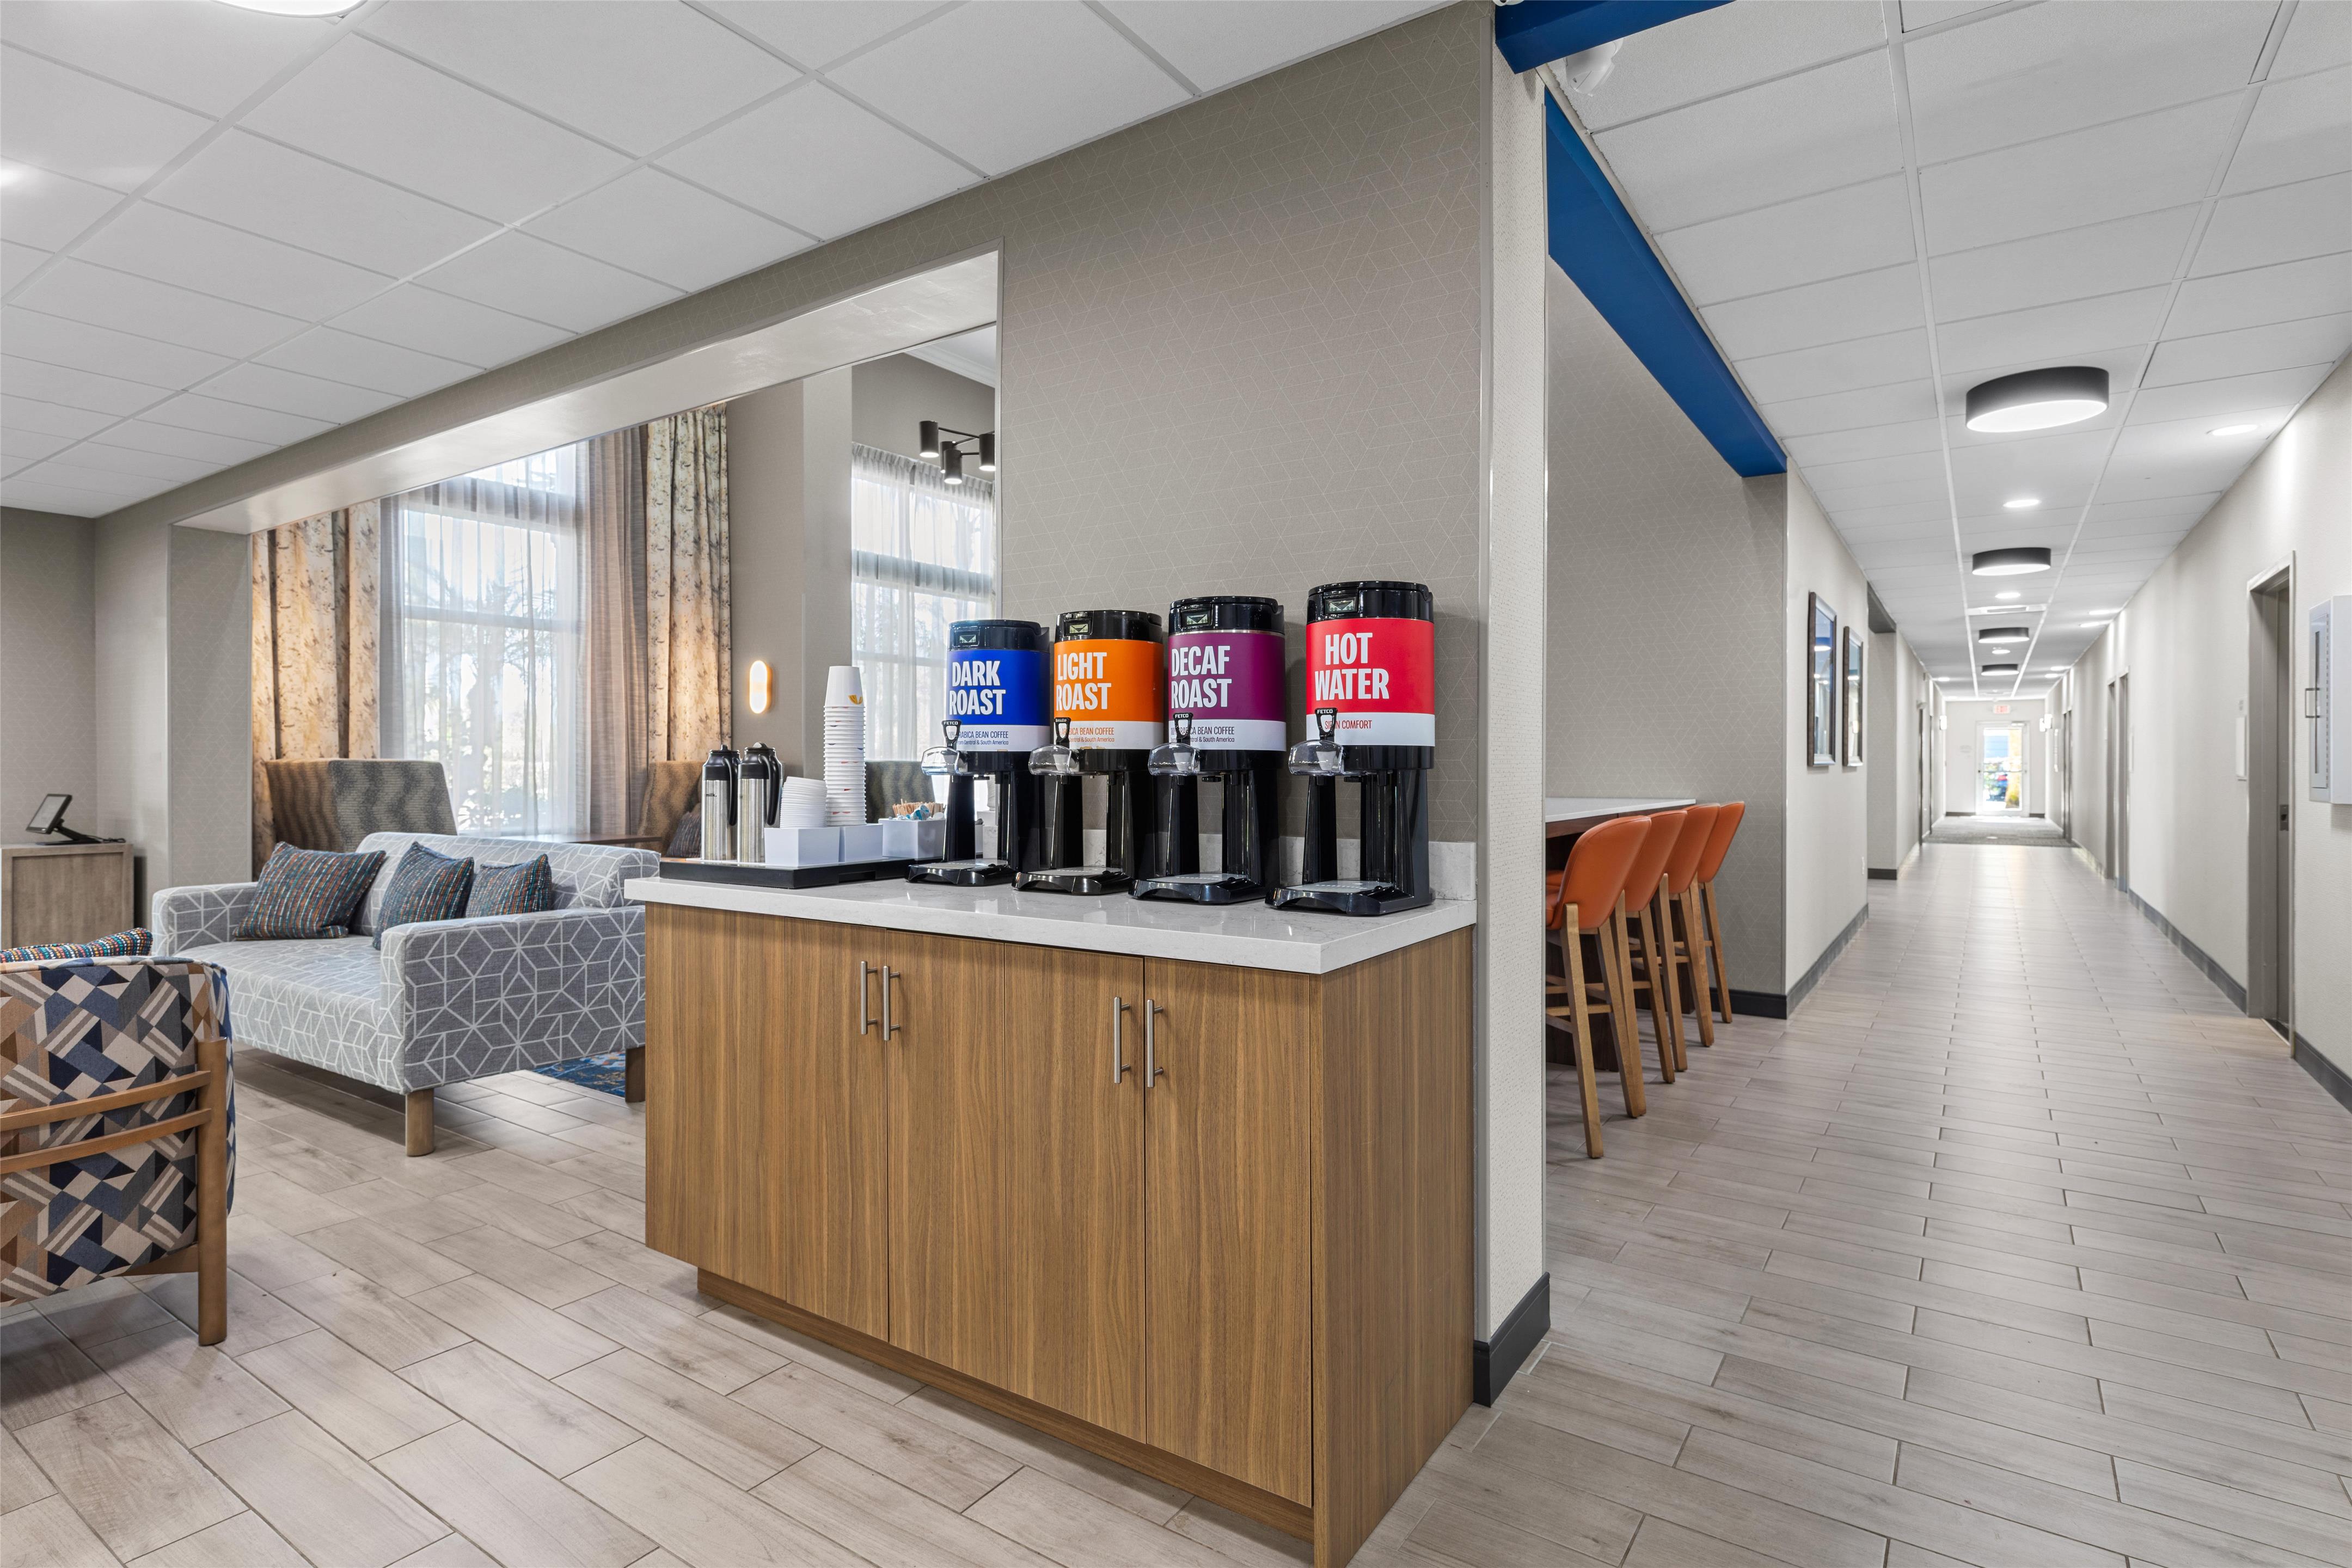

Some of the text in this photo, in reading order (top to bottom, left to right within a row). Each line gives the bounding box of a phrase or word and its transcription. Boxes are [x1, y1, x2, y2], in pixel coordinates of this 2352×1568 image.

[1172, 646, 1230, 677] DECAF
[1325, 633, 1373, 665] HOT
[952, 660, 1001, 687] DARK
[1058, 652, 1107, 681] LIGHT
[1056, 682, 1112, 711] ROAST
[1171, 678, 1232, 709] ROAST
[1315, 668, 1389, 701] WATER
[949, 689, 1006, 715] ROAST
[1342, 720, 1372, 729] COMFORT
